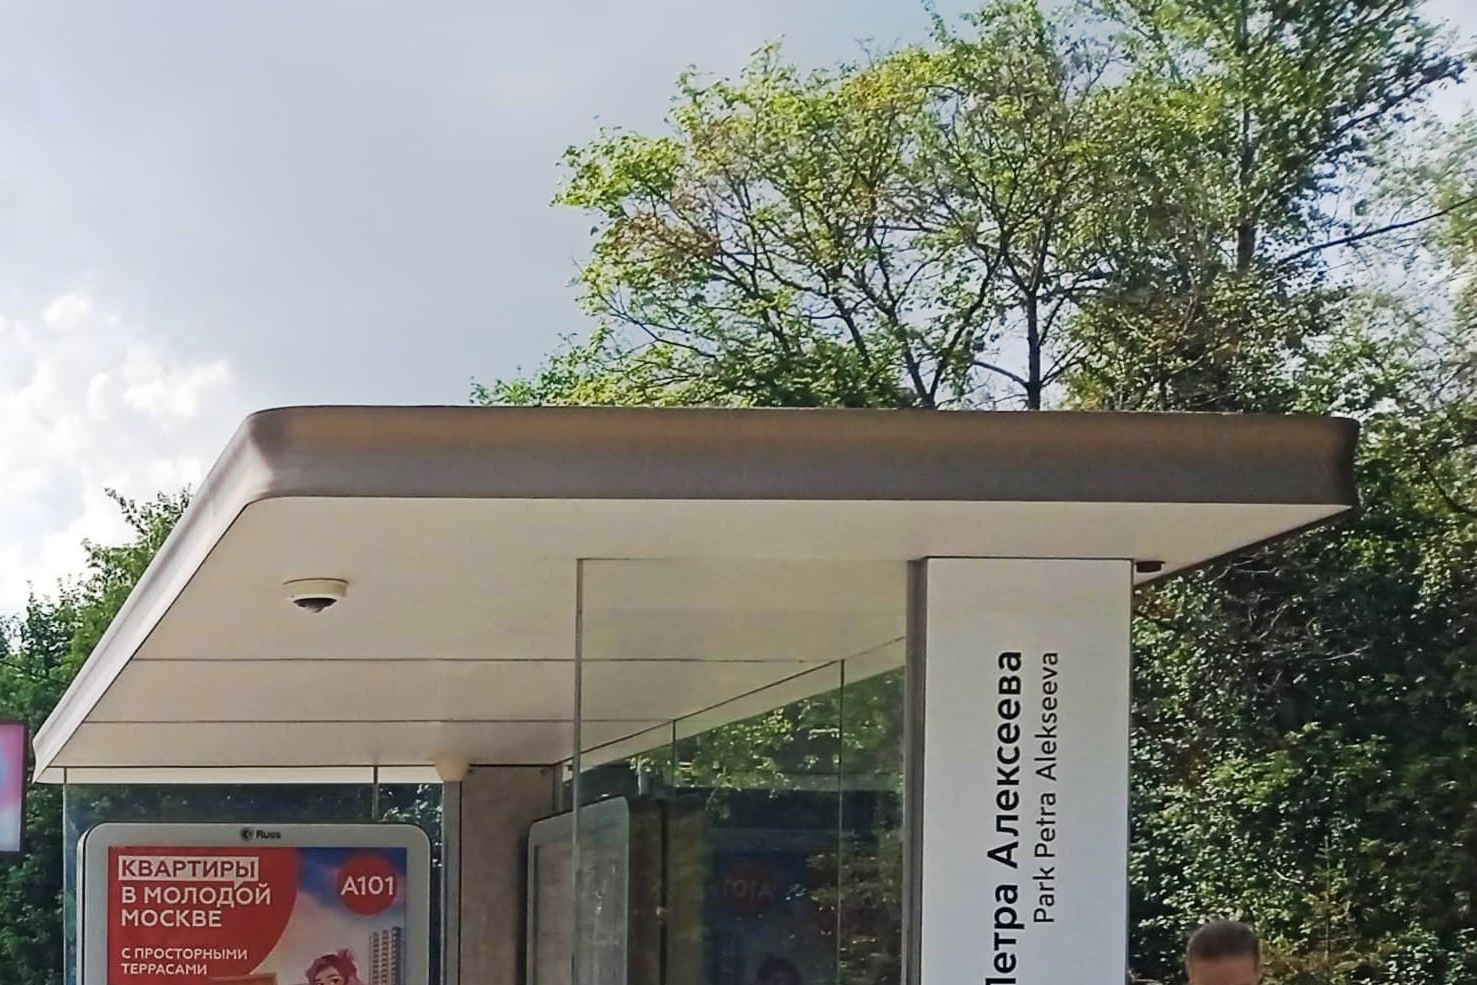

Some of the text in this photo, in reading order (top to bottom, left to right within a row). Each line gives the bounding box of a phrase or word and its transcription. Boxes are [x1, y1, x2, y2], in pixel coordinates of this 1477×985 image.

[987, 651, 1022, 869] Алексеева
[1032, 652, 1058, 923] Park Petra Alekseeva
[122, 860, 255, 878] КВАРТИРЫ
[122, 883, 271, 908] В МОЛОДОЙ
[122, 910, 222, 927] МОСКВЕ
[121, 948, 248, 960] С ПРОСТОРНЫМИ
[121, 963, 207, 975] ТЕРРАСАМИ
